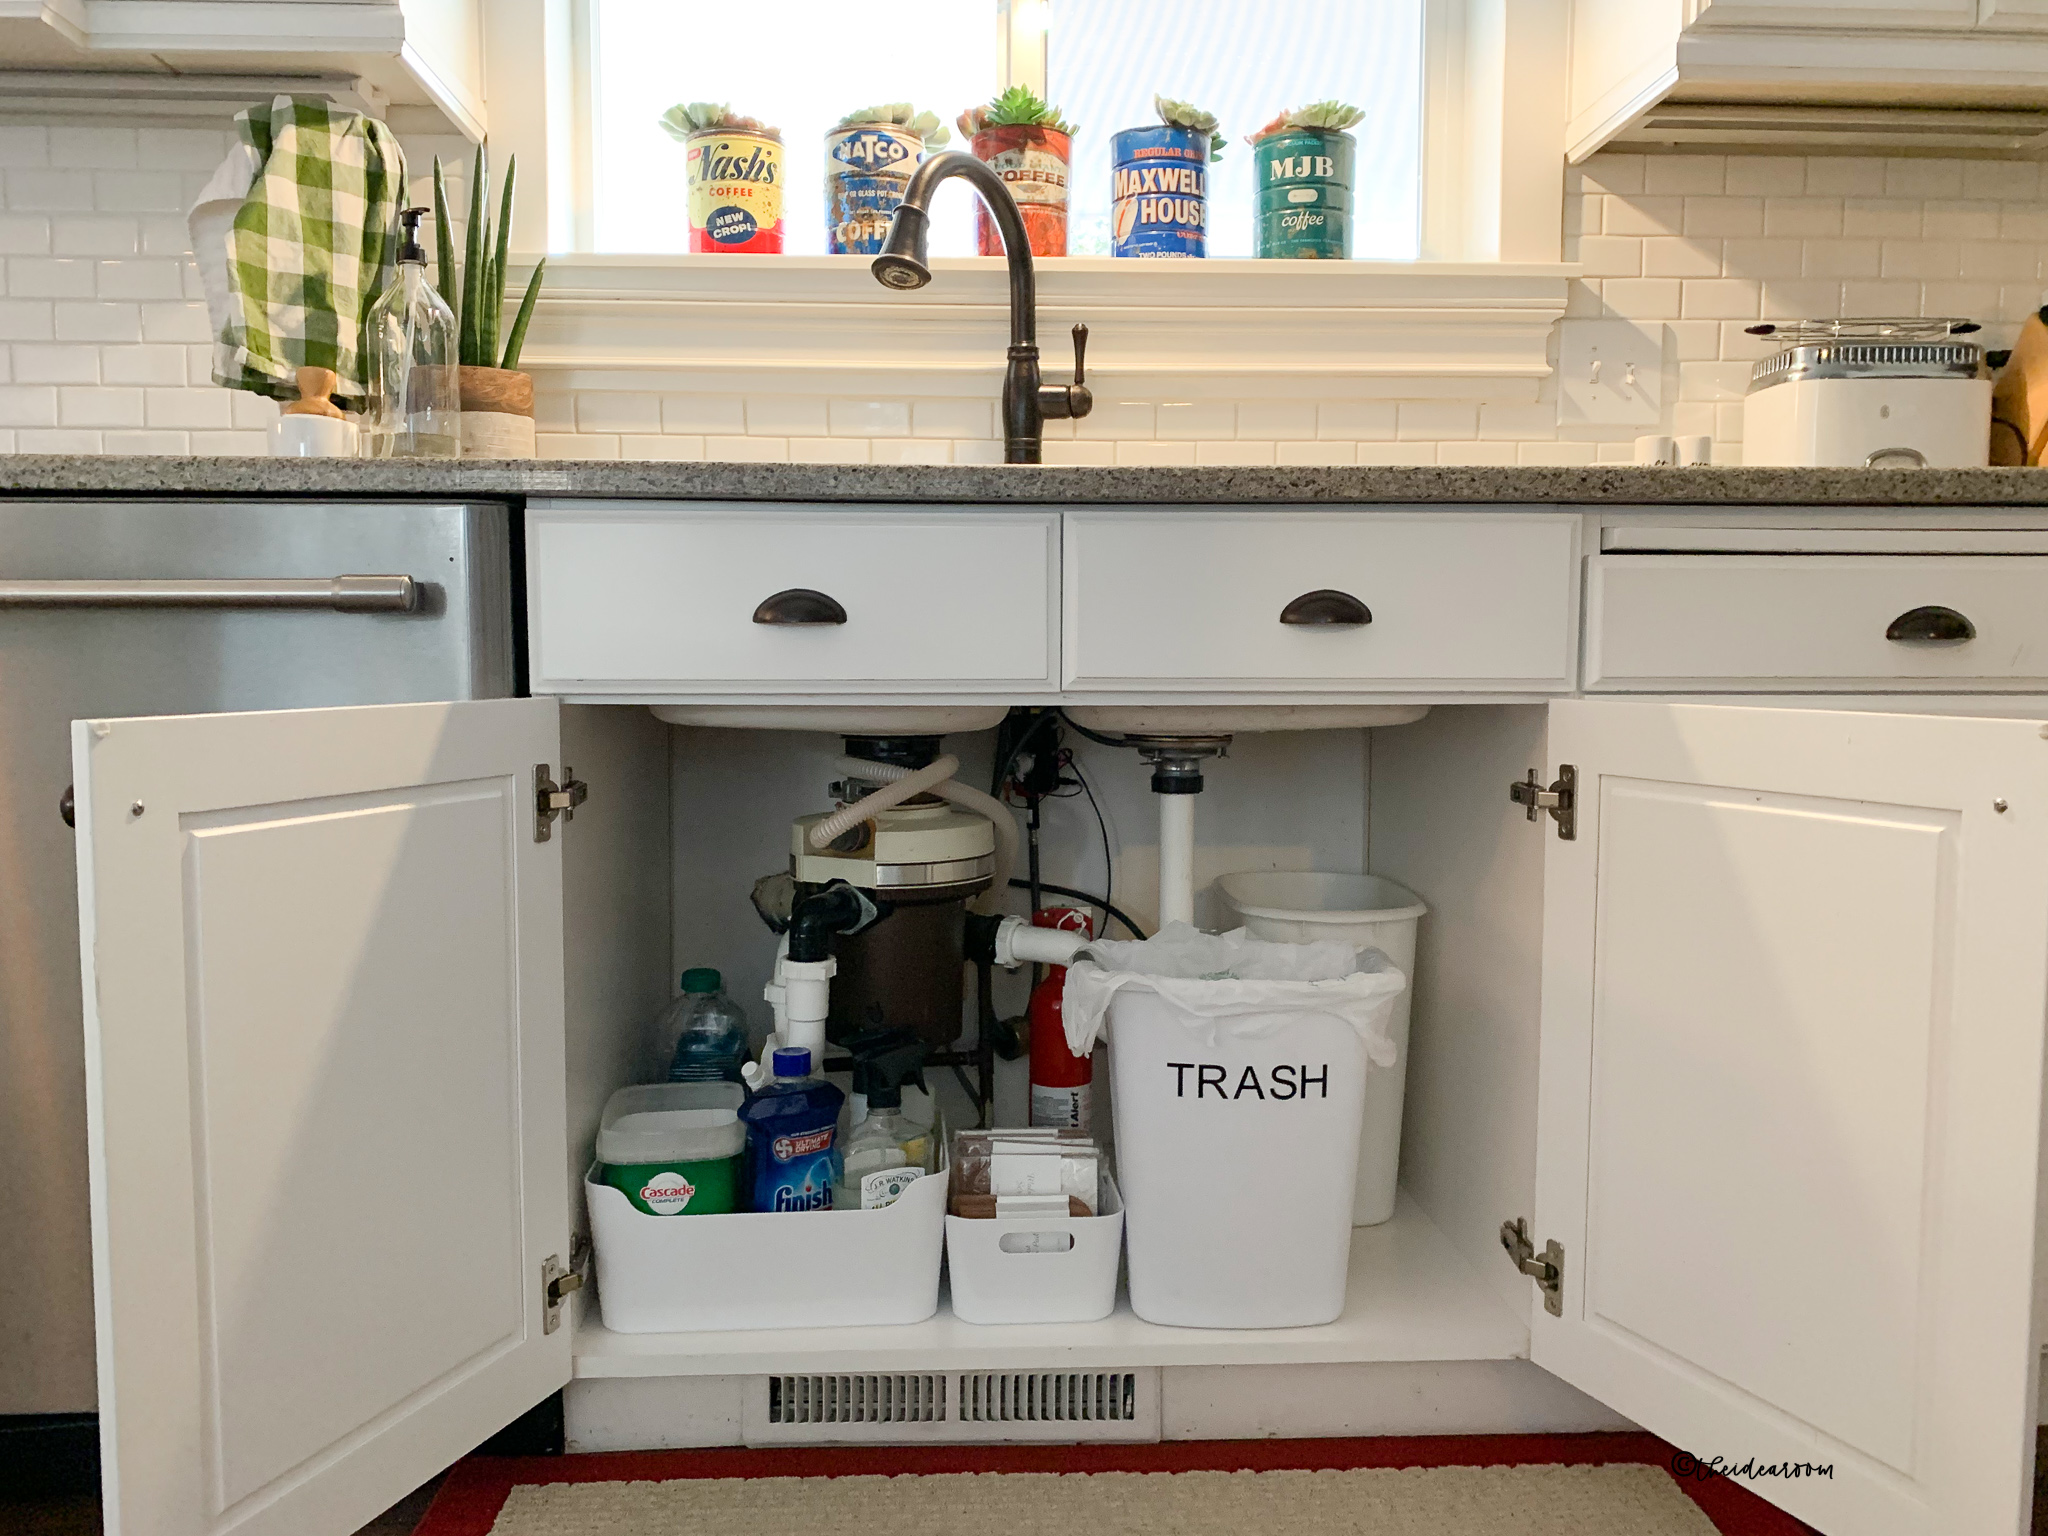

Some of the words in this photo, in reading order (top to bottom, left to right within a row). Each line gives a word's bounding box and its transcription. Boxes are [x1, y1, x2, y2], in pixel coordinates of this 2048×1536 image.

[839, 134, 904, 163] NATCO
[1133, 147, 1182, 159] REGULAR
[688, 143, 777, 185] Nash's
[1270, 156, 1334, 181] MJB
[996, 169, 1065, 188] OFFEE
[1114, 167, 1206, 200] MAXWELL
[709, 187, 753, 198] COFFEE
[715, 211, 744, 227] NEW
[1141, 197, 1206, 227] HOUSE
[1281, 211, 1324, 231] coffee
[713, 222, 752, 239] CROP!
[1167, 1062, 1328, 1101] TRASH
[1070, 1092, 1079, 1122] Alert
[640, 1184, 695, 1200] Cascade
[774, 1178, 832, 1212] finish
